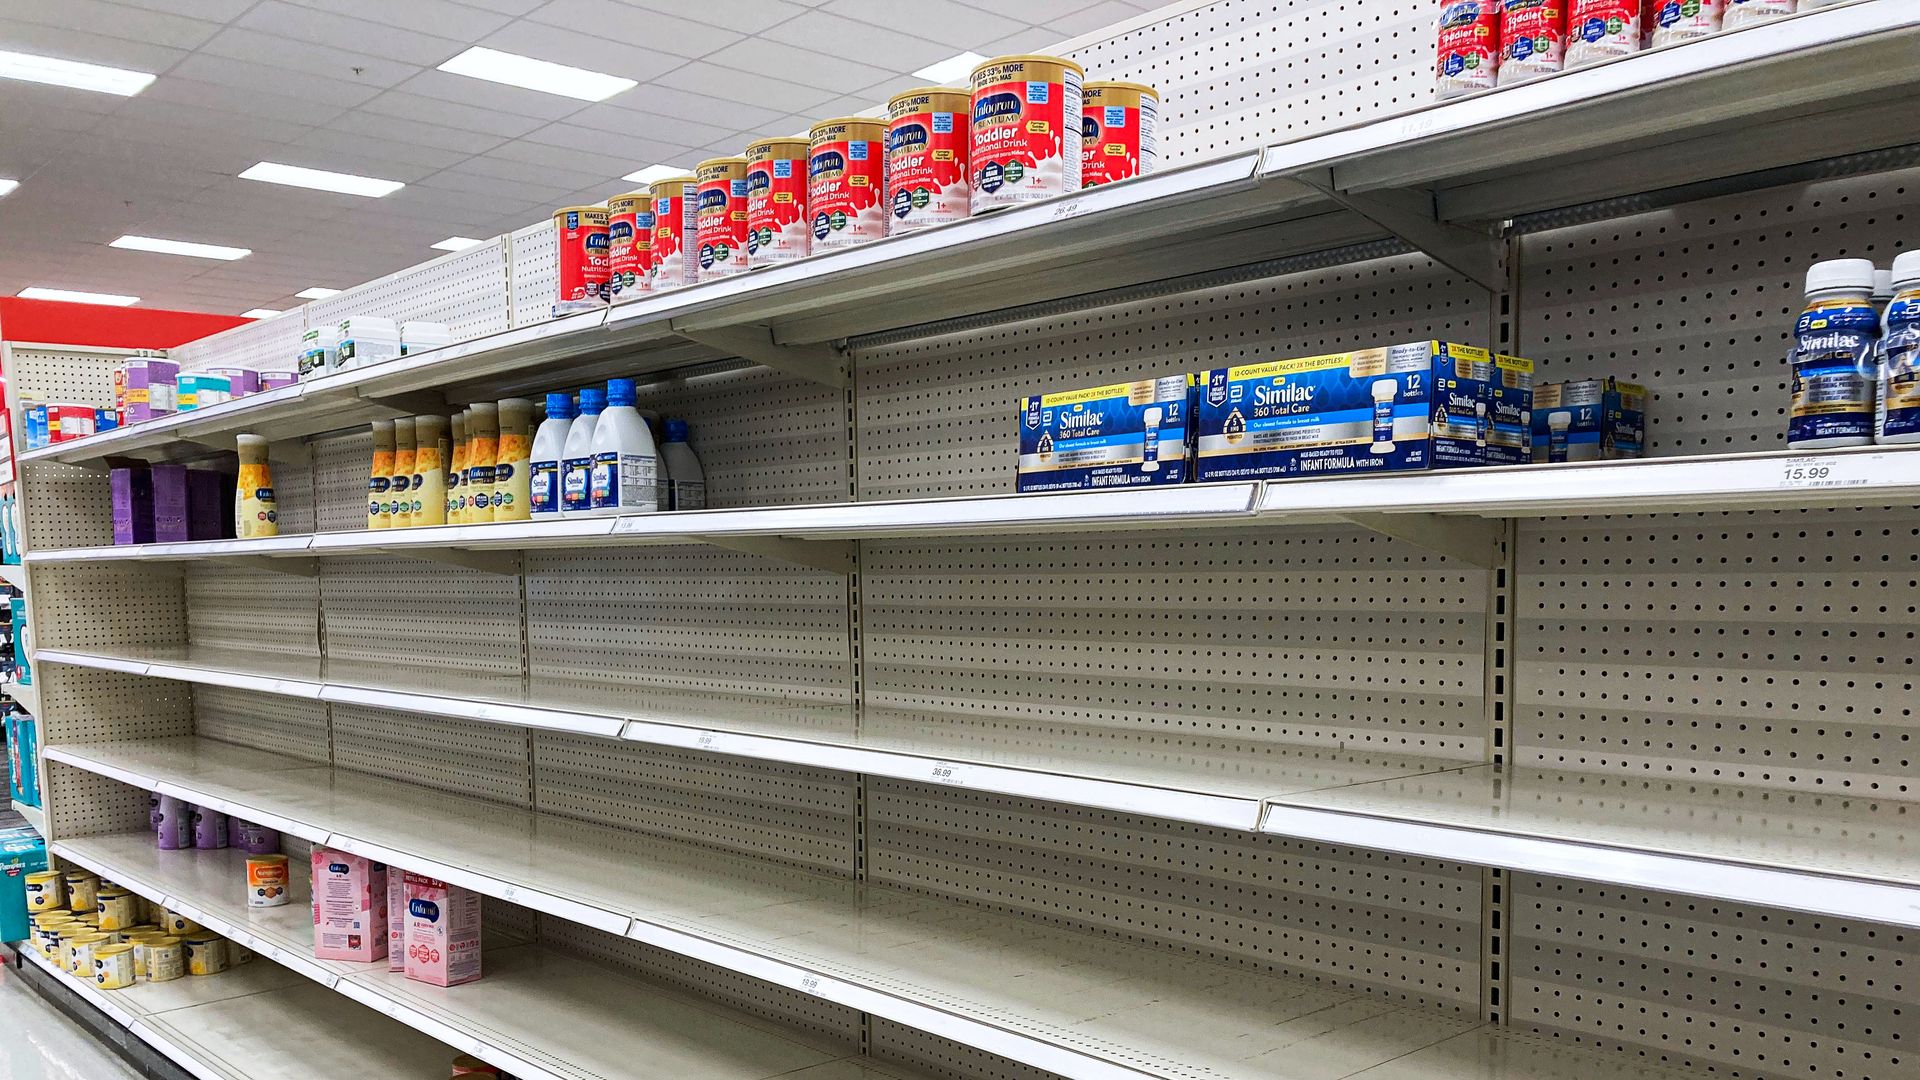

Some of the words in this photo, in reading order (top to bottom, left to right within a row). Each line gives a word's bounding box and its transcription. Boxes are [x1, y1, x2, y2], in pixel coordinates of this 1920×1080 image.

[987, 67, 1000, 77] 33%
[1002, 63, 1024, 73] MORE
[1082, 89, 1102, 98] MORE
[910, 96, 929, 105] MORE
[908, 105, 919, 113] MAS
[974, 99, 1017, 119] Enfagrow
[828, 125, 846, 134] MORE
[974, 126, 1018, 147] Toddler
[756, 145, 772, 154] MORE
[1003, 139, 1028, 148] Drink
[712, 165, 729, 174] MORE
[911, 166, 933, 175] Drink
[1082, 160, 1105, 170] Drink
[1031, 176, 1042, 185] 1+
[829, 191, 850, 200] Drink
[936, 201, 947, 209] 1+
[584, 212, 604, 220] MAKES
[1797, 331, 1860, 353] Similac
[1391, 346, 1426, 355] Ready-to-Use
[1457, 346, 1466, 354] THE
[1234, 368, 1260, 377] 12-COUNT
[1304, 360, 1316, 368] THE
[1316, 357, 1344, 367] BOTTLES!
[1406, 374, 1421, 389] 12
[1253, 380, 1316, 407] Similac
[1402, 389, 1424, 397] bottles
[1449, 392, 1476, 408] Similac
[1168, 403, 1179, 417] 12
[1253, 407, 1268, 417] 360
[1271, 405, 1290, 415] Total
[1291, 403, 1310, 414] Care
[1495, 400, 1521, 417] Similac
[1580, 408, 1593, 420] 12
[1060, 409, 1104, 430] Similac
[1059, 431, 1071, 439] 360
[1071, 429, 1085, 438] Total
[1086, 427, 1100, 436] Care
[1300, 459, 1323, 472] INFANT
[1323, 457, 1355, 470] FORMULA
[1355, 459, 1369, 467] WITH
[1369, 458, 1384, 466] IRON
[1784, 467, 1830, 480] 15.99
[1091, 476, 1109, 487] INFANT
[1109, 474, 1131, 485] FORMULA
[932, 767, 952, 778] 36.99
[411, 902, 436, 915] Enfamil
